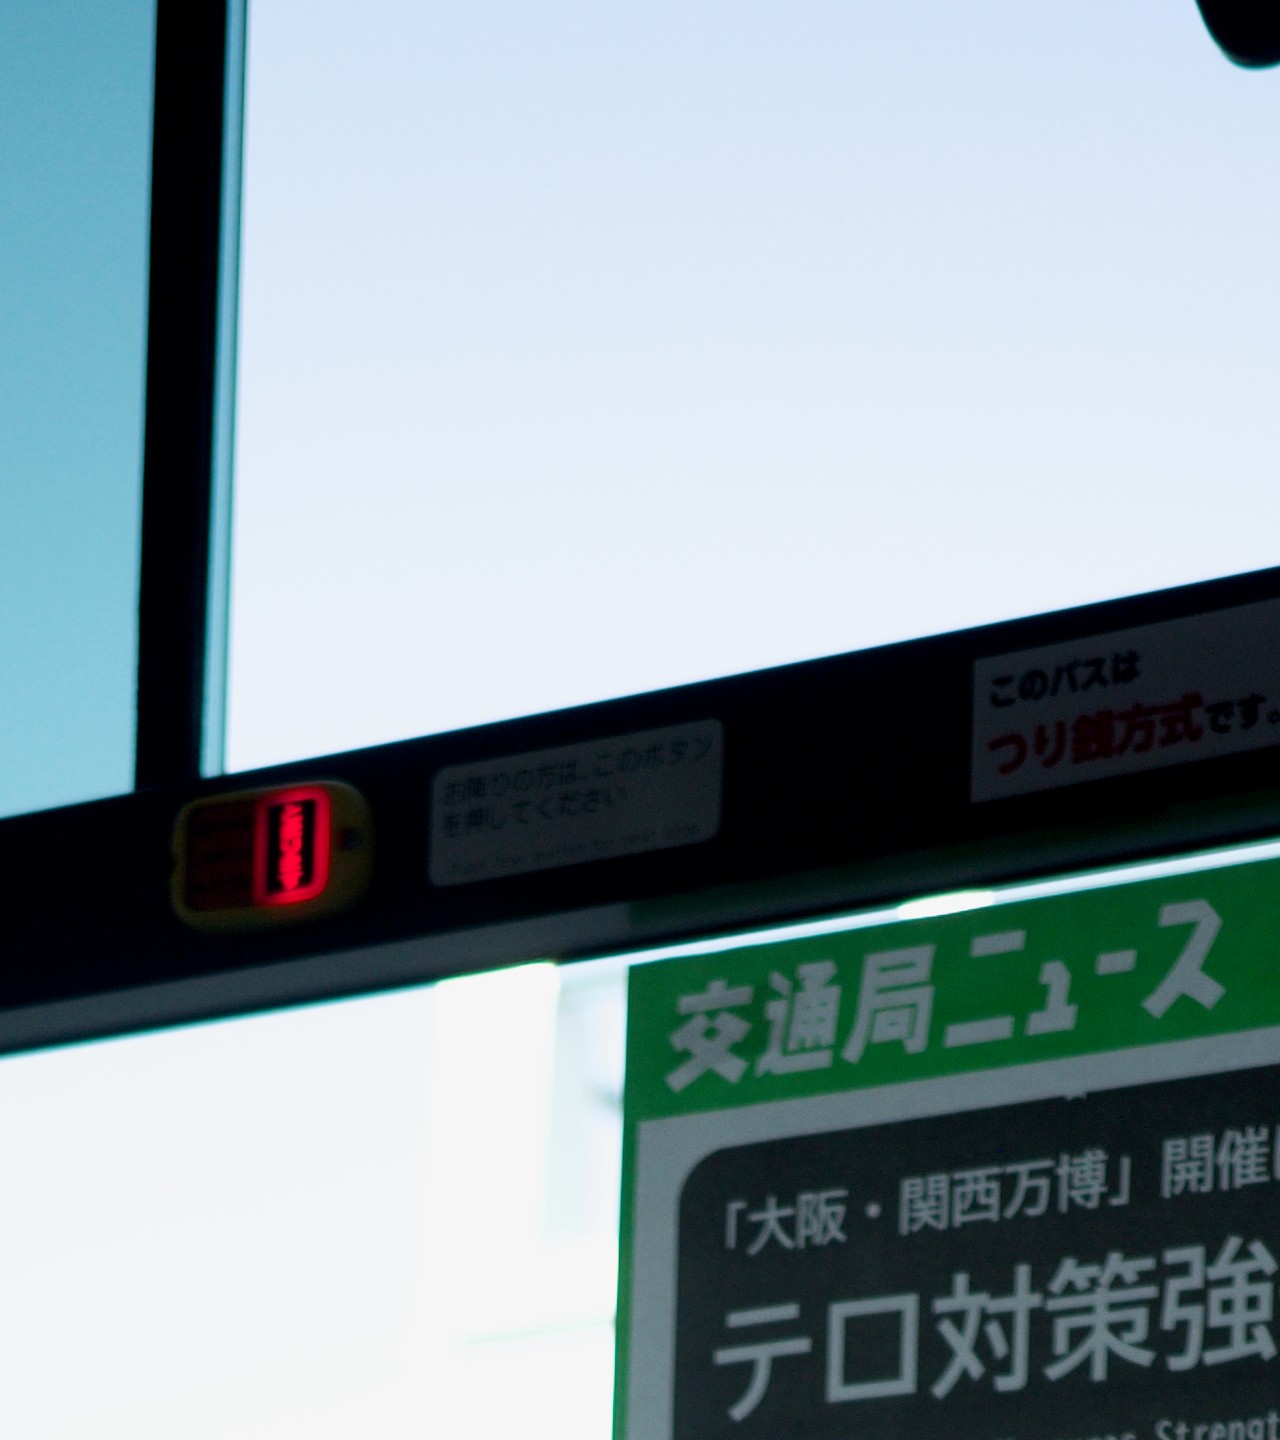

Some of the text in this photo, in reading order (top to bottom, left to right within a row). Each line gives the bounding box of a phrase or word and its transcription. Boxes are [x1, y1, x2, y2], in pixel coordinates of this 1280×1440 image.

[990, 649, 1141, 706] このバスは
[663, 899, 1227, 1093] 交通局ニュース
